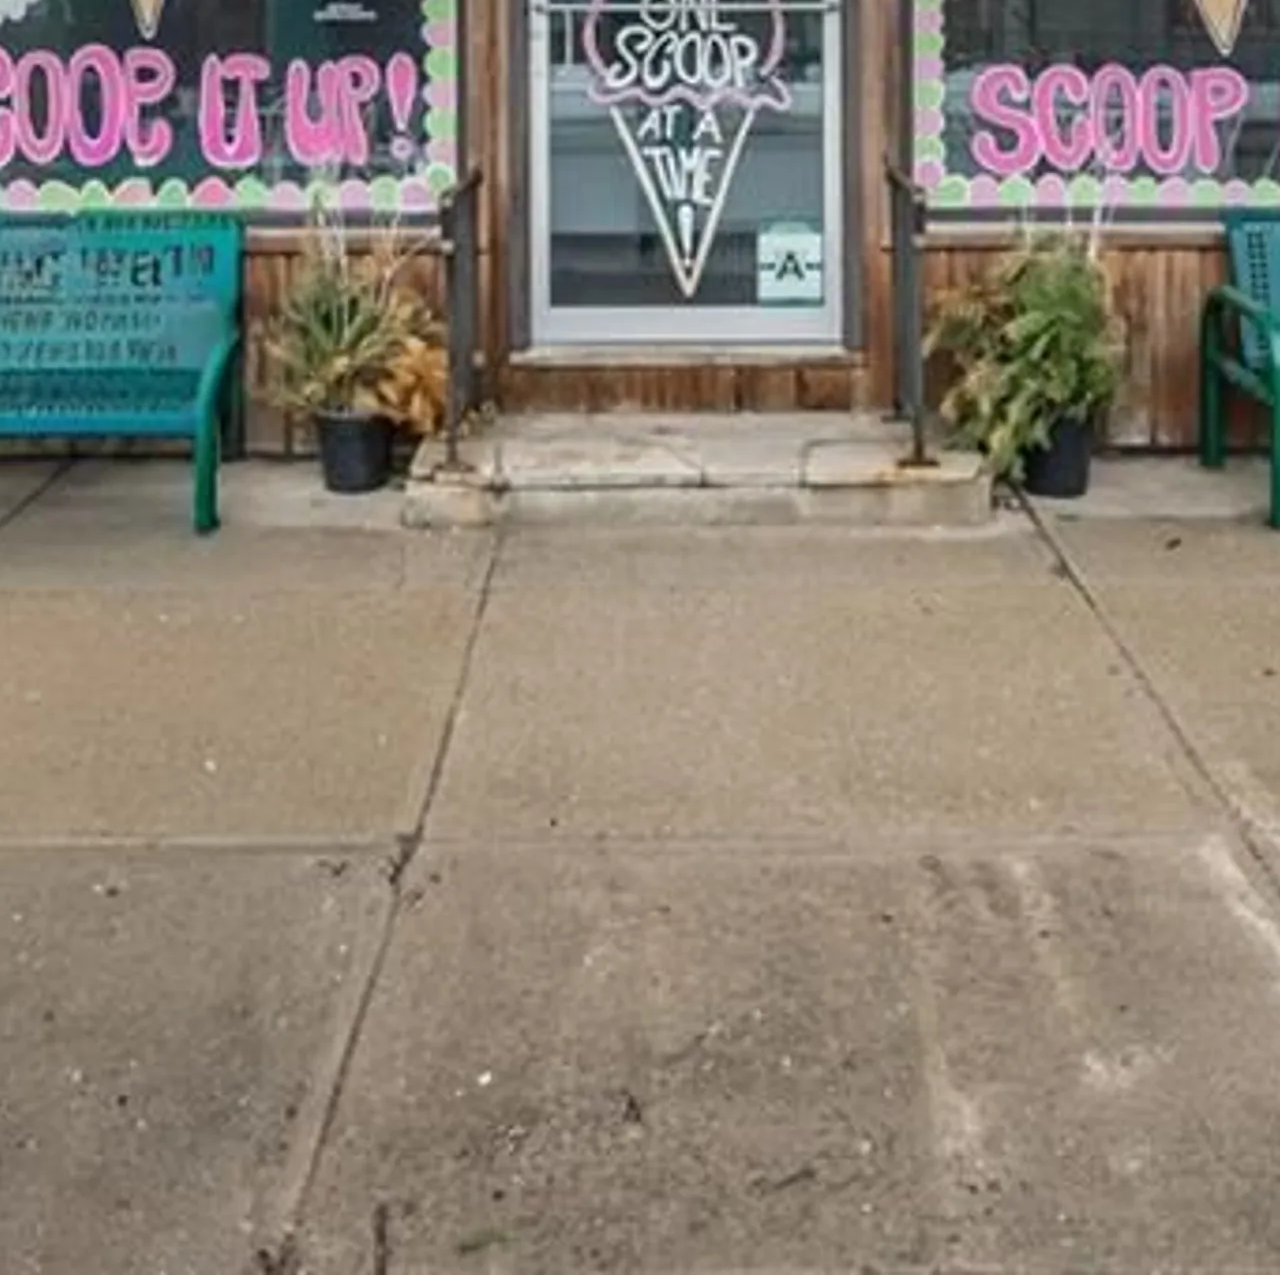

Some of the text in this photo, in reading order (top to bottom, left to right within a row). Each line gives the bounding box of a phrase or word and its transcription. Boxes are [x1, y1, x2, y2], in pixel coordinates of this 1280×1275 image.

[606, 24, 758, 90] SCOOP
[285, 53, 418, 168] UP!
[636, 104, 724, 144] AT A
[970, 63, 1249, 176] SCOOP
